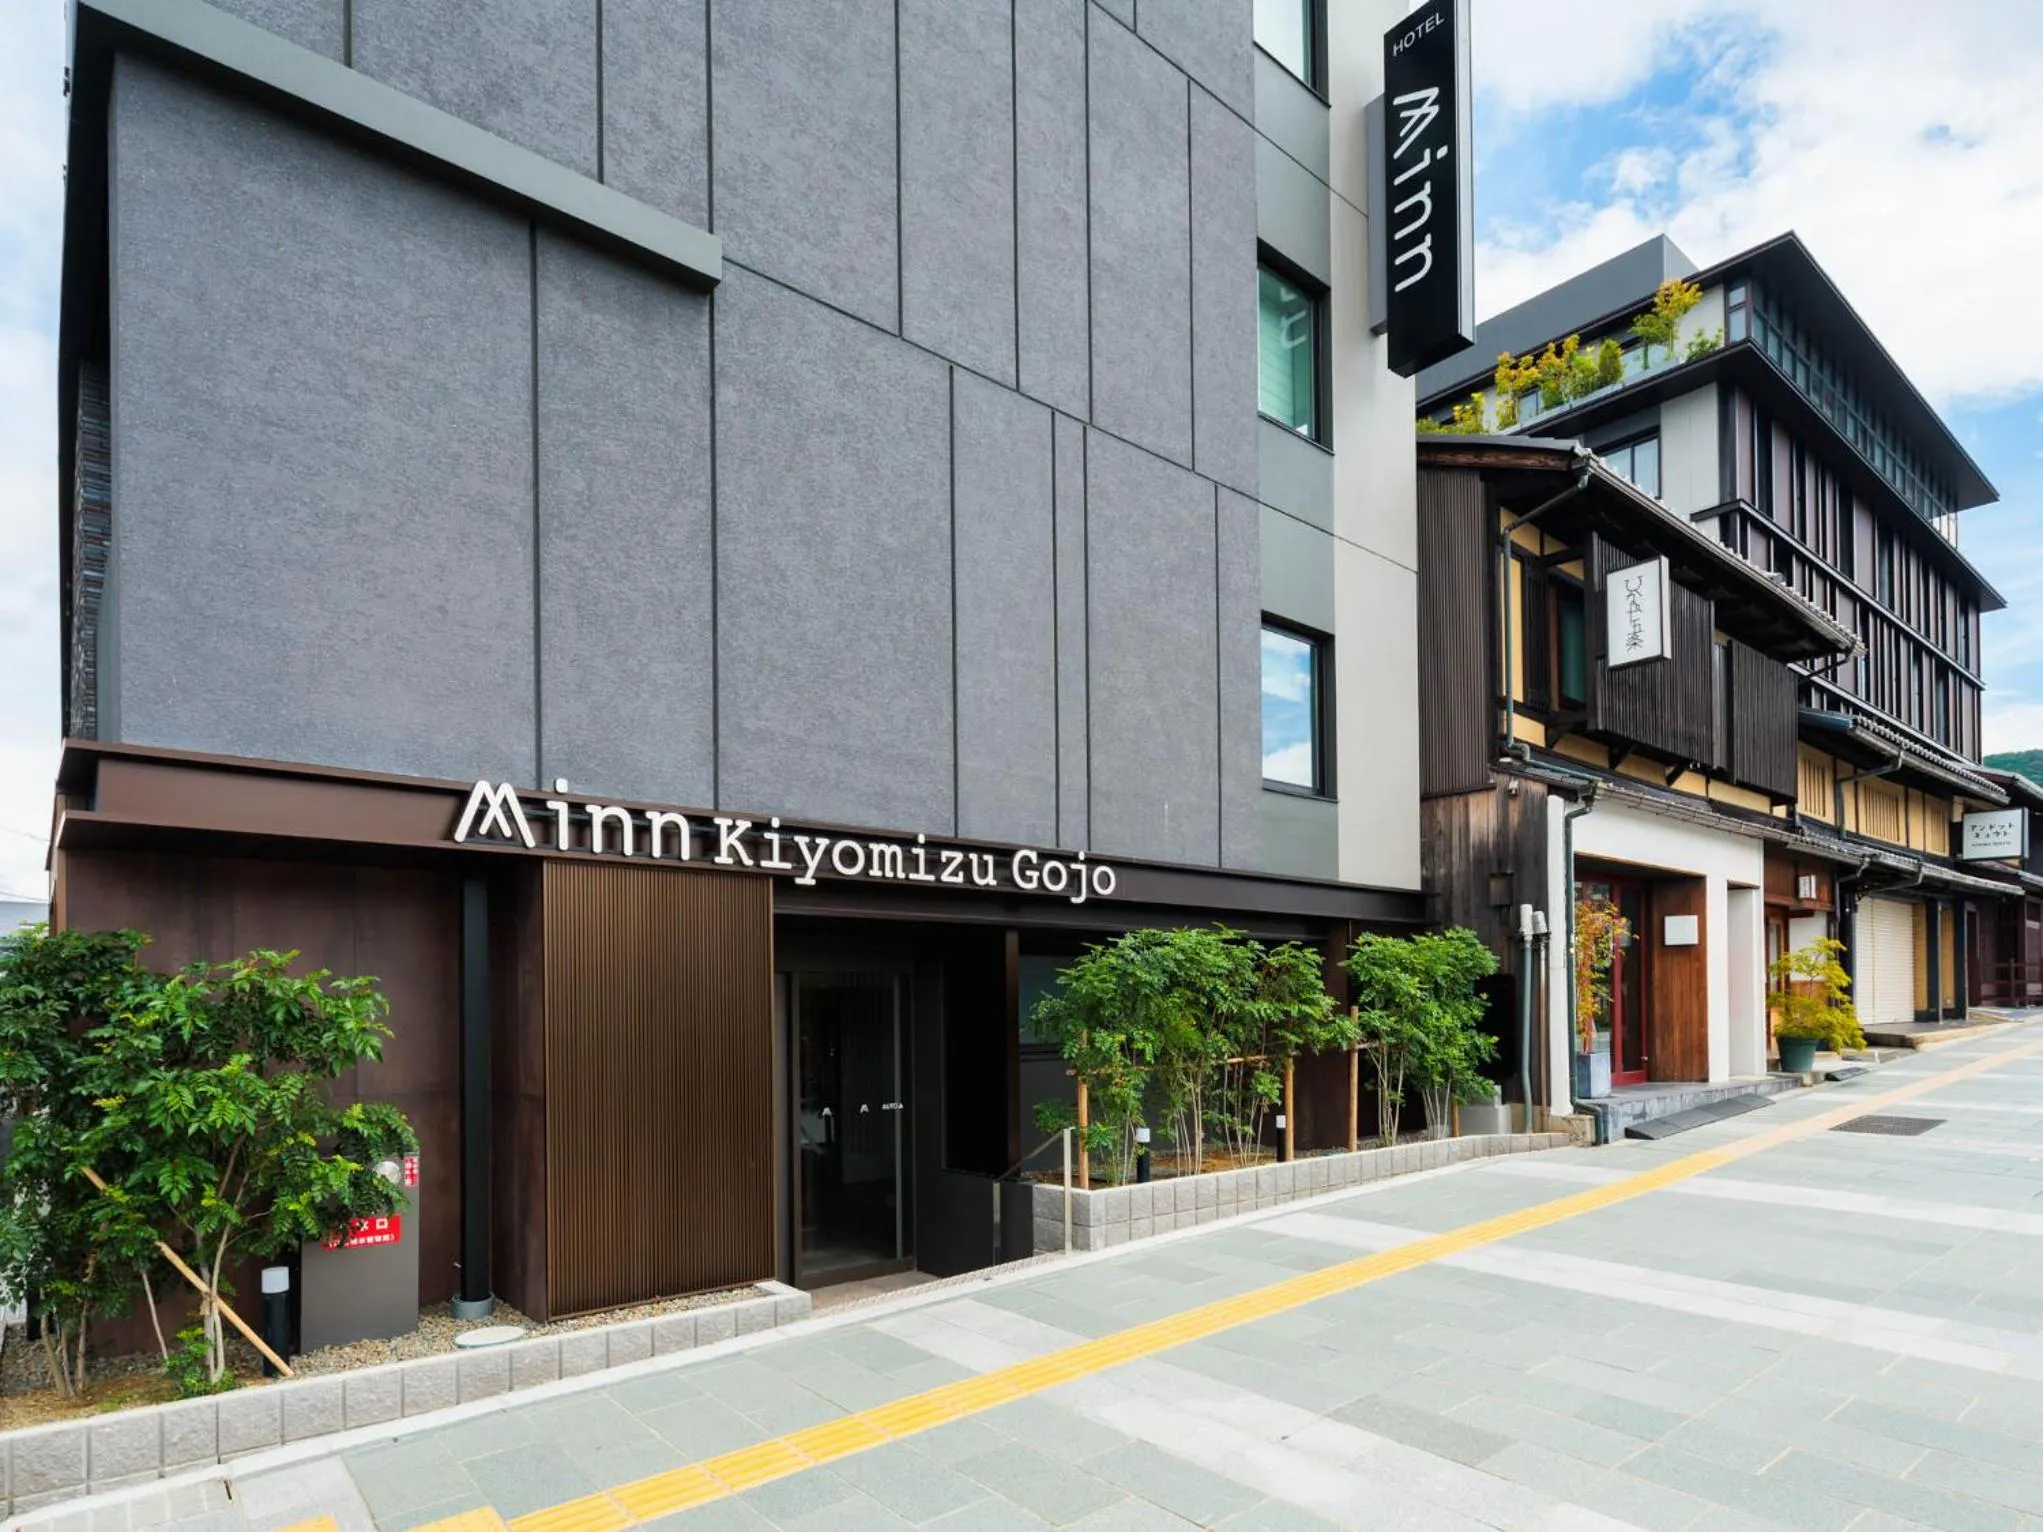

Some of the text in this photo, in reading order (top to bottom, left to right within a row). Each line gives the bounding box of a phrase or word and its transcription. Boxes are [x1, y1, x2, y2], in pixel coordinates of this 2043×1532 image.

[1392, 12, 1445, 57] HOTEL
[1392, 86, 1449, 292] Minn
[453, 778, 1117, 904] Minn Kiyomizu Gojo
